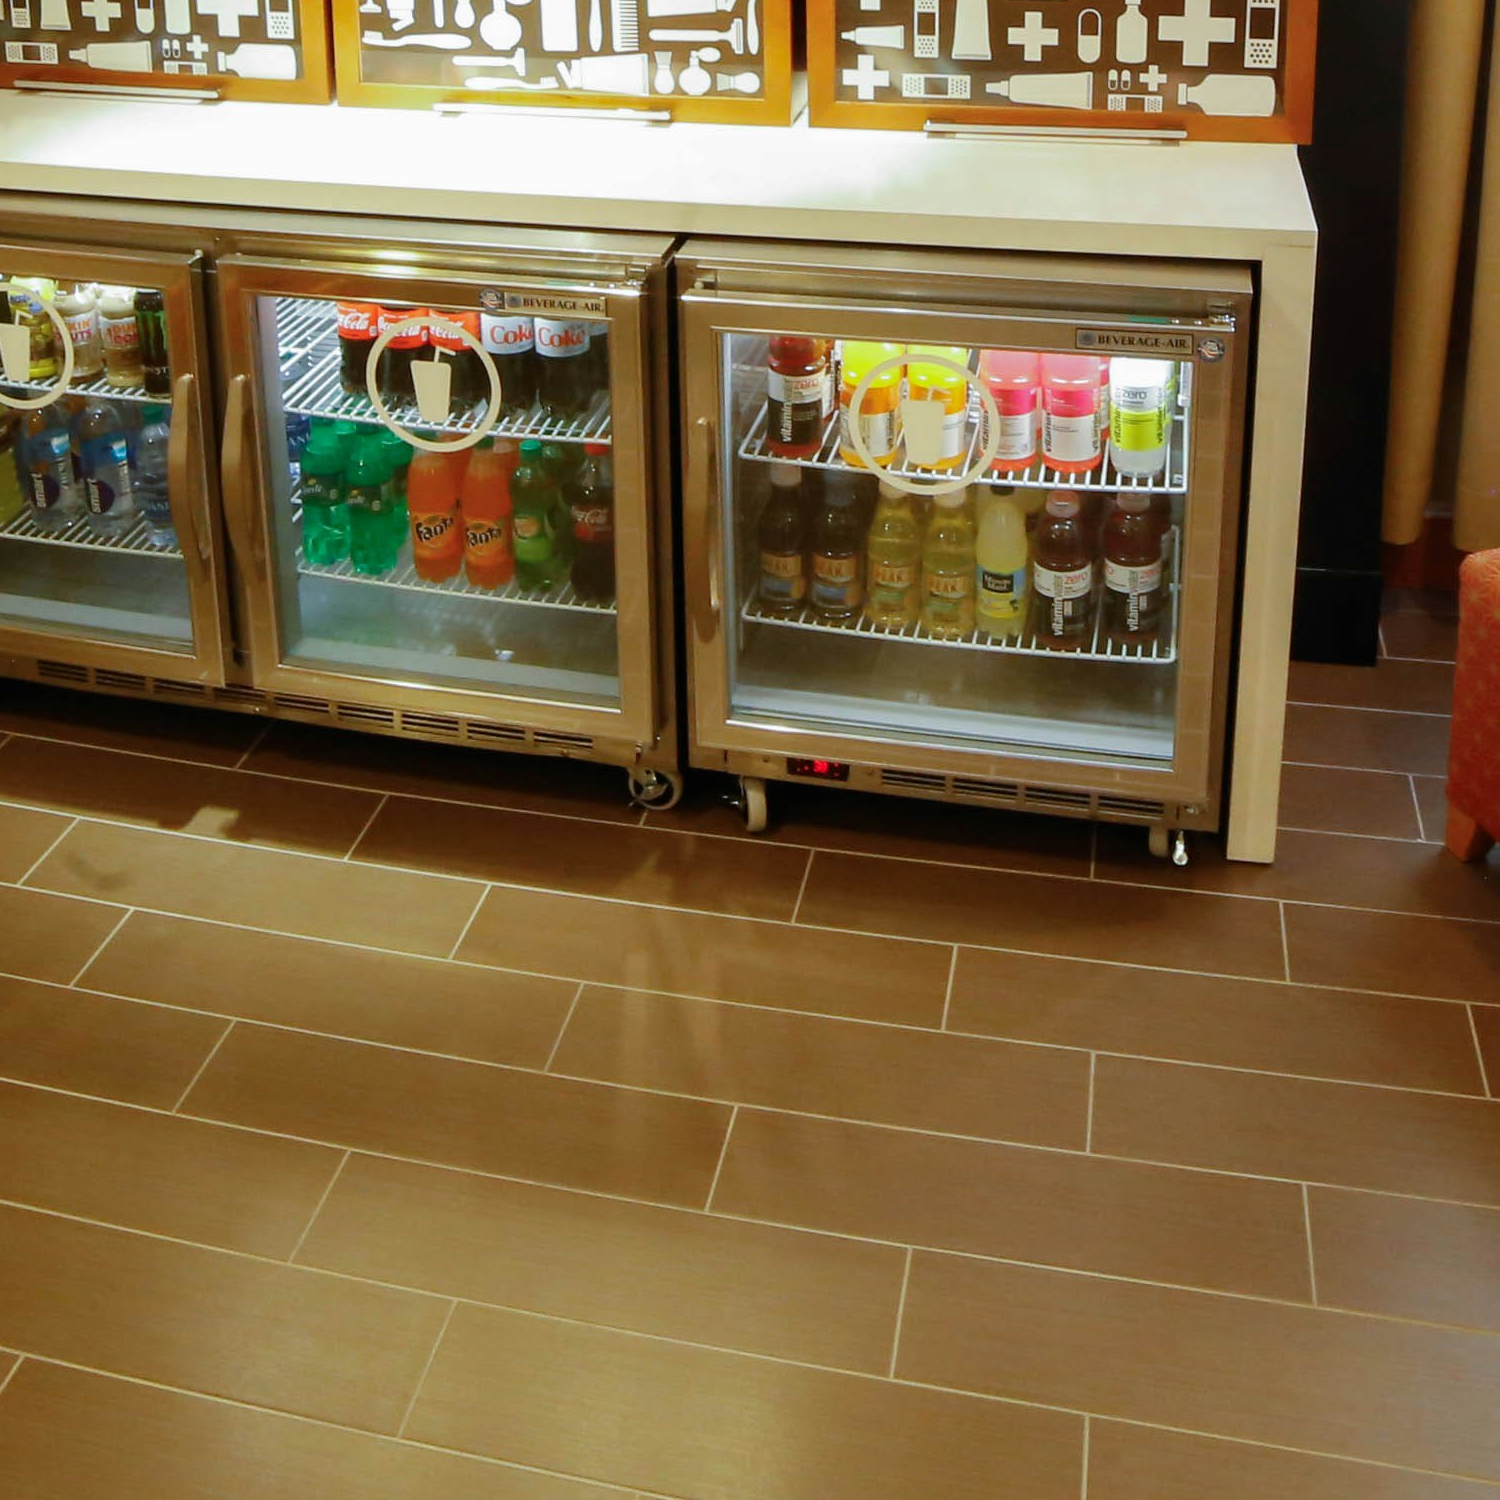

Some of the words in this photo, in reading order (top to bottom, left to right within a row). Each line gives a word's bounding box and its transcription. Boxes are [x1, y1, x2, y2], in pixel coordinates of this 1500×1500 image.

[538, 326, 586, 348] Coke
[1121, 388, 1148, 401] zero
[415, 514, 454, 543] Fanta
